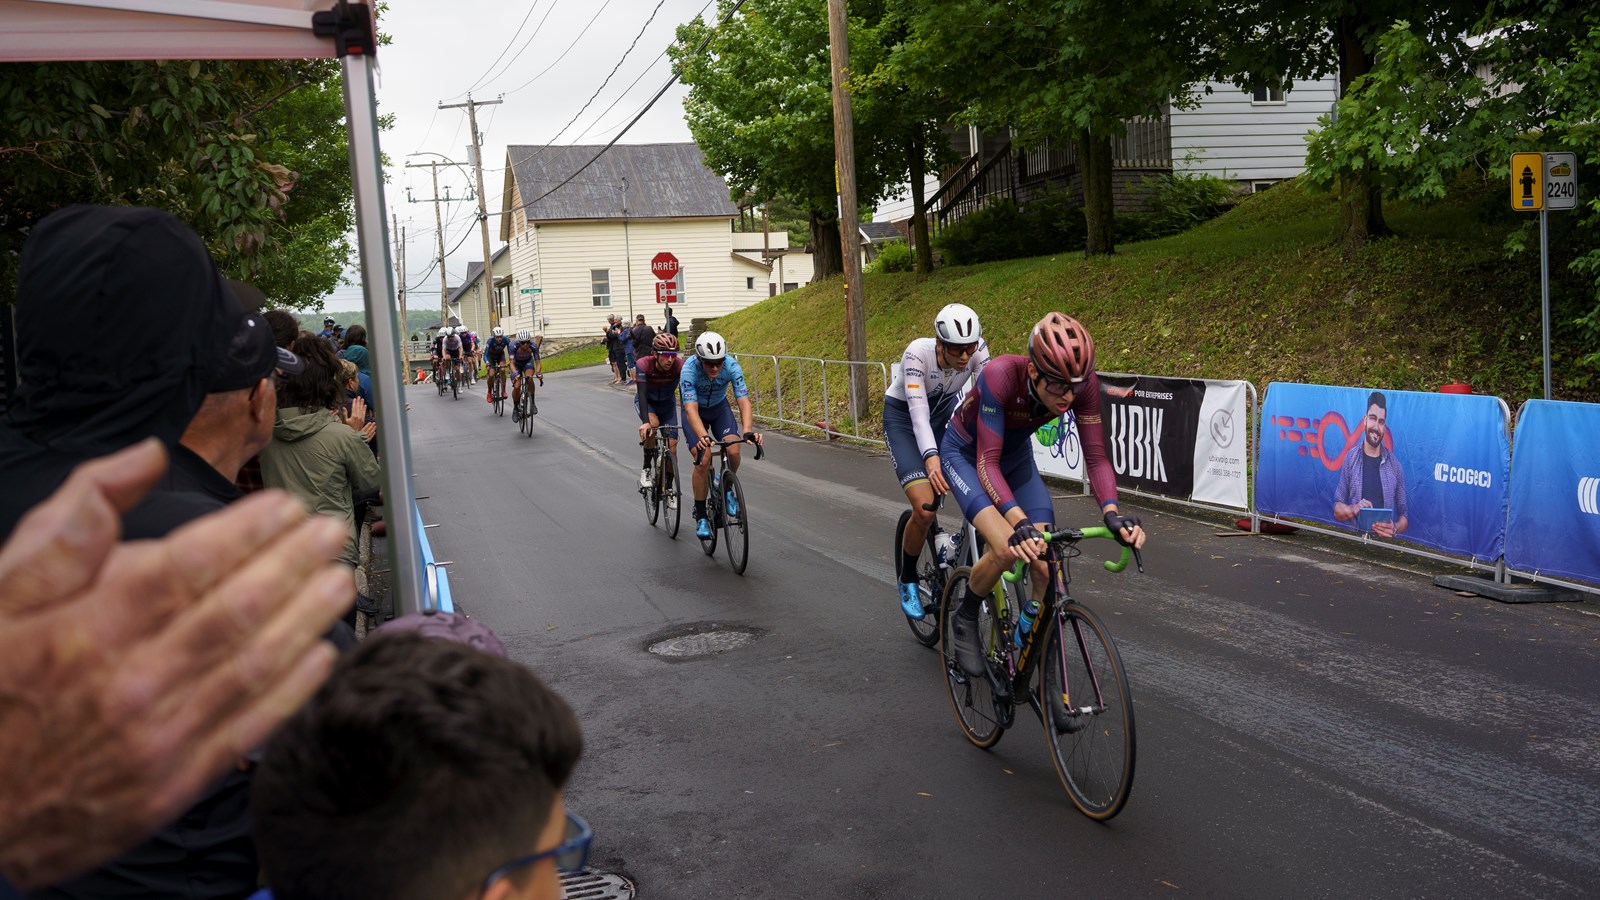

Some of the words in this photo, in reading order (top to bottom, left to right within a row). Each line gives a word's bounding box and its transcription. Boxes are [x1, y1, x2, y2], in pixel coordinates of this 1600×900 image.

[1548, 181, 1575, 198] 2240
[652, 260, 678, 271] ARRÊT
[1110, 403, 1168, 483] UBIK
